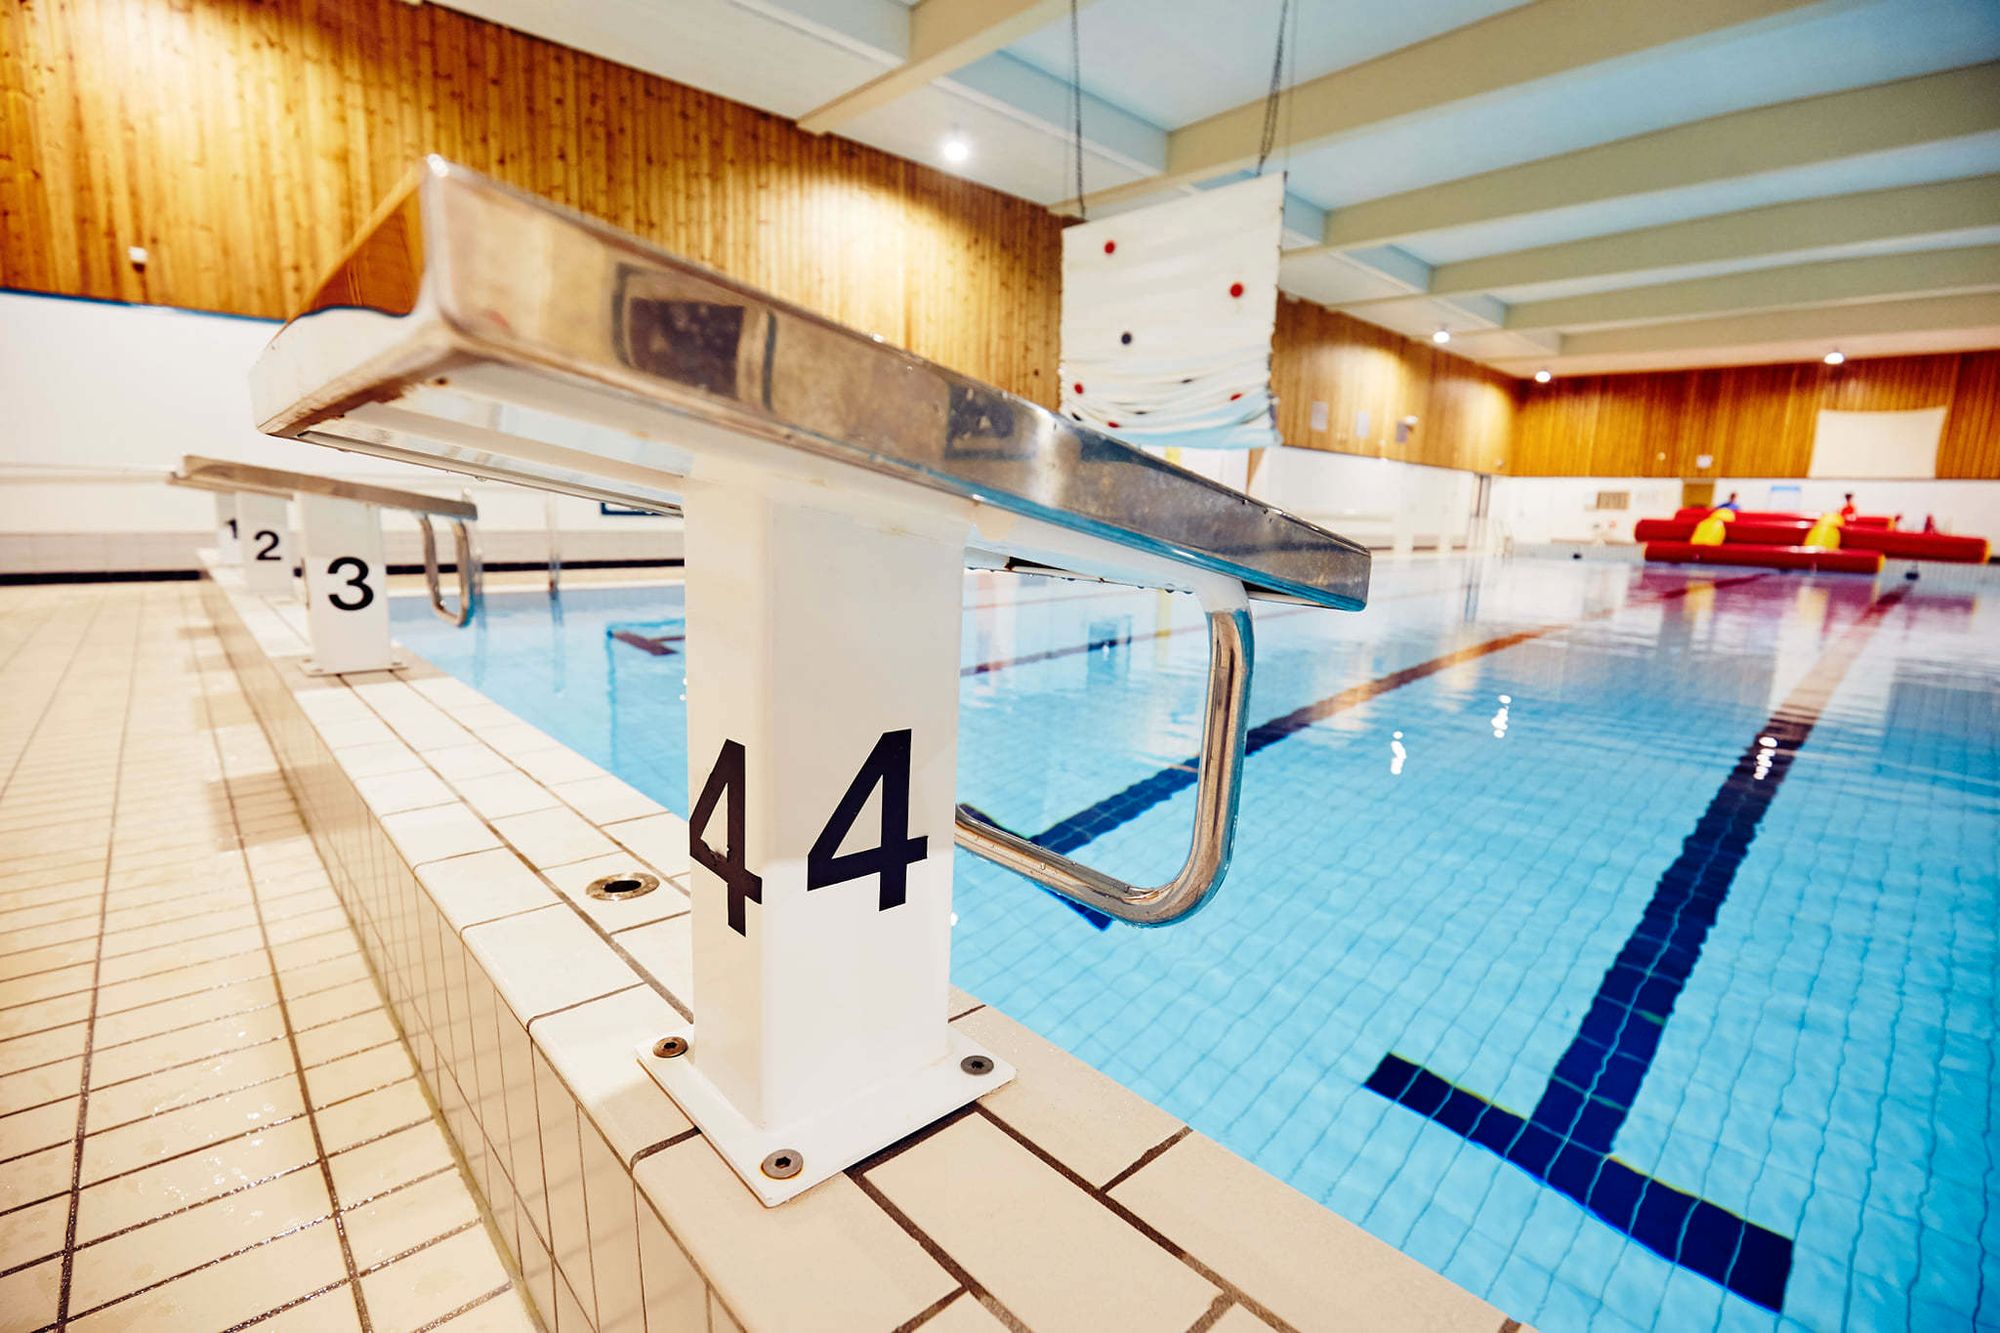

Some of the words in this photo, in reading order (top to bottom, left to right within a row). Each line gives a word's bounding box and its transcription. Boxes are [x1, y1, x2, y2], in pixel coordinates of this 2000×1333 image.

[254, 530, 282, 561] 2
[327, 556, 374, 611] 3
[690, 739, 762, 937] 4
[807, 728, 928, 911] 4
